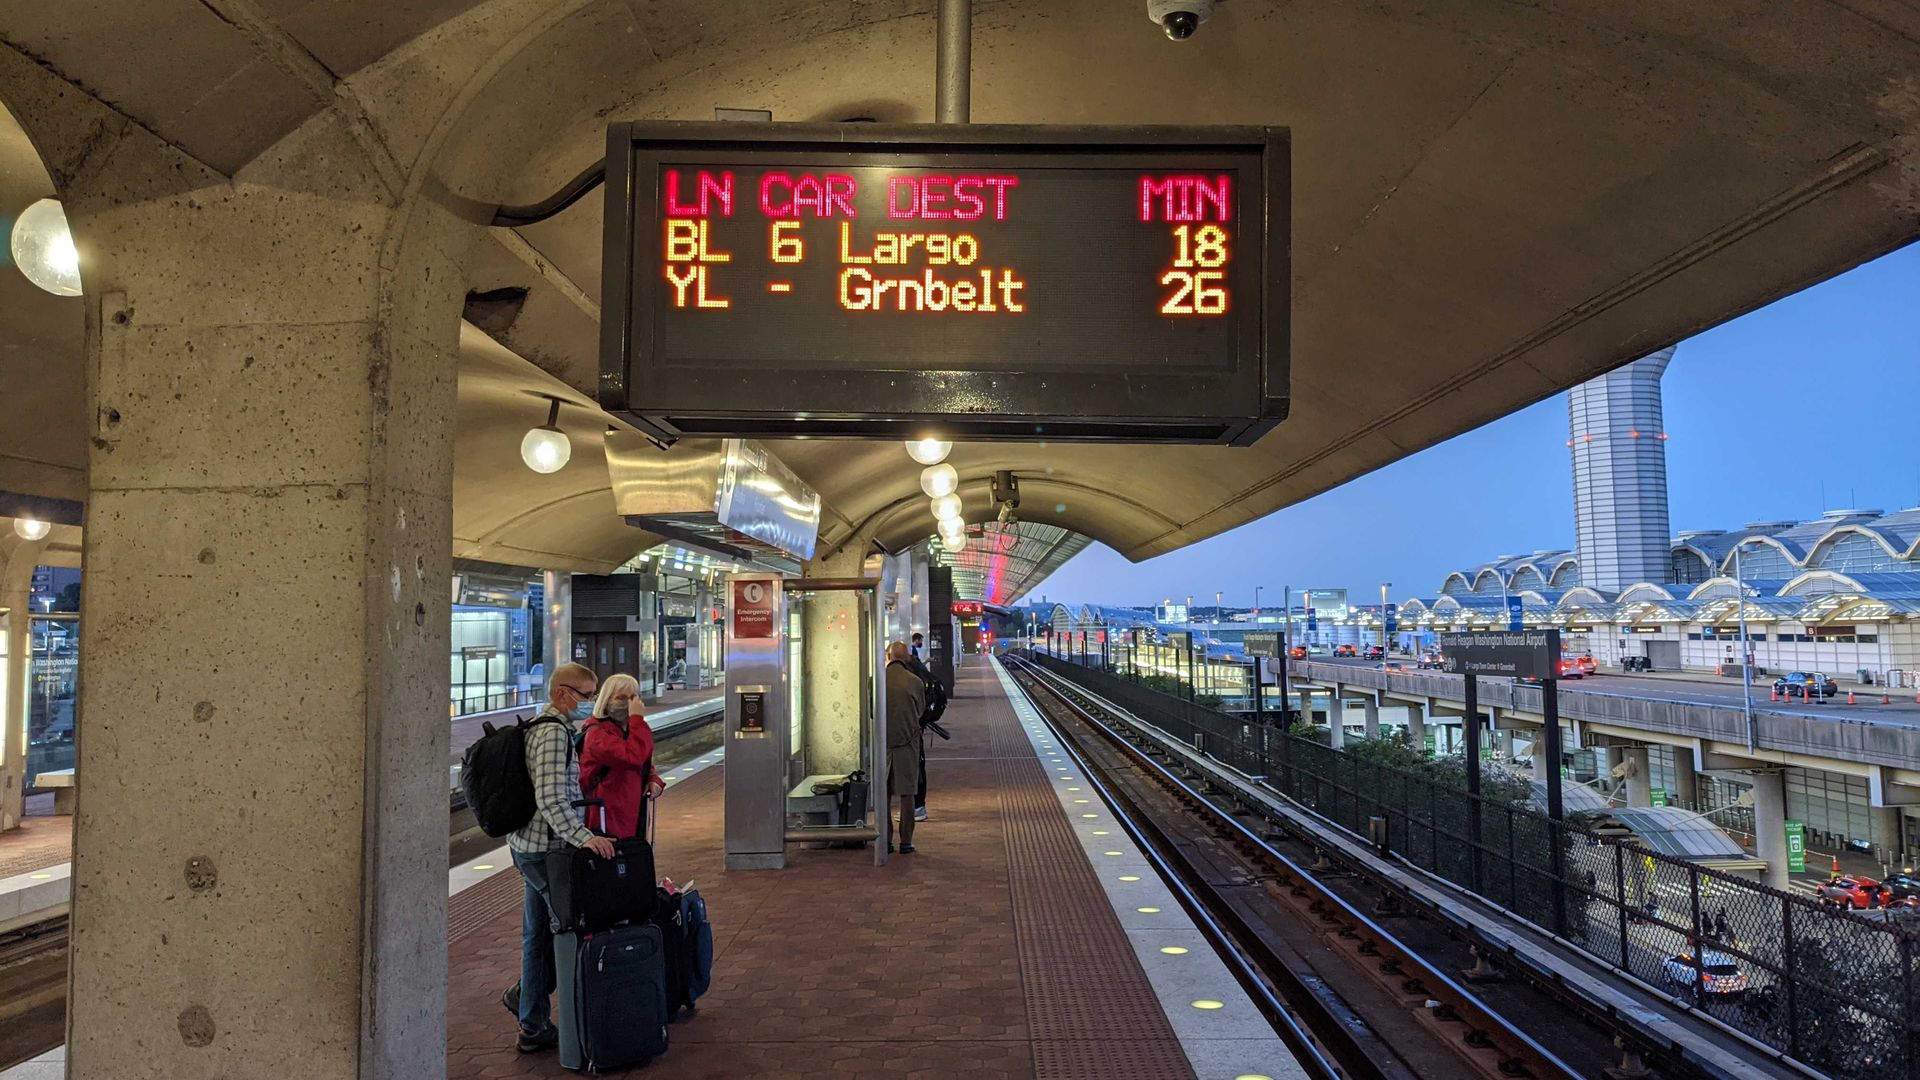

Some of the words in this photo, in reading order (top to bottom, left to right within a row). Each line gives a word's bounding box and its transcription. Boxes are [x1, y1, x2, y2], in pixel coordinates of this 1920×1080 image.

[666, 172, 732, 217] LN
[760, 173, 856, 218] CAR
[888, 175, 1018, 221] DEST
[1140, 175, 1229, 221] MIN
[666, 219, 730, 263] BL
[770, 220, 803, 263] 6
[840, 221, 979, 266] Largo
[1172, 225, 1227, 268] 18
[666, 266, 729, 308] YL
[840, 267, 1025, 313] Grnbelt
[1161, 271, 1227, 315] 26
[737, 608, 770, 616] Emergency
[1457, 633, 1474, 648] Reagan
[1474, 633, 1503, 649] Washington
[1503, 632, 1525, 646] National
[1526, 632, 1547, 649] Airport
